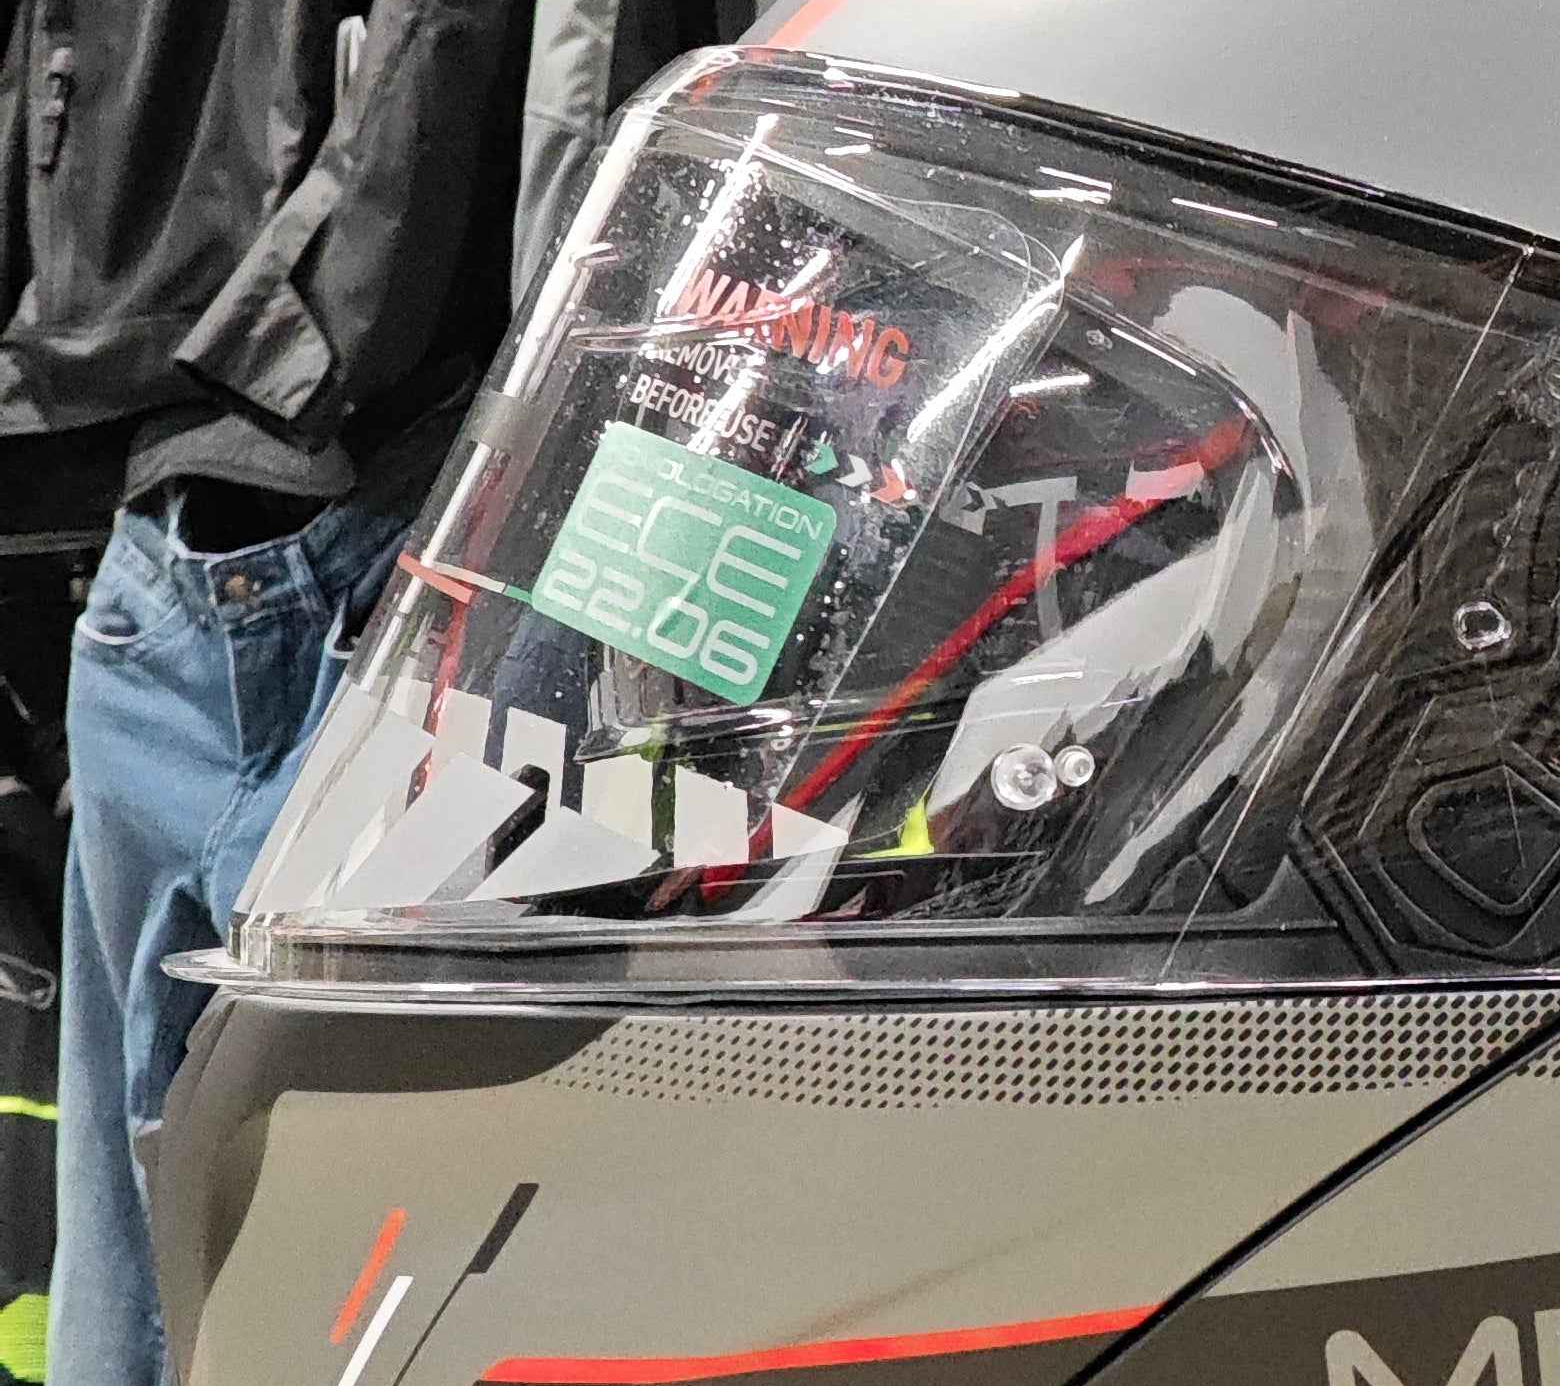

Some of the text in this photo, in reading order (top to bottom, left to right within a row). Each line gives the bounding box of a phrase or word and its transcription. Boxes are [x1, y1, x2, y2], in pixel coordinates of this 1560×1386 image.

[672, 268, 909, 390] WARNING
[576, 469, 802, 619] ECE
[542, 549, 771, 686] 22.06
